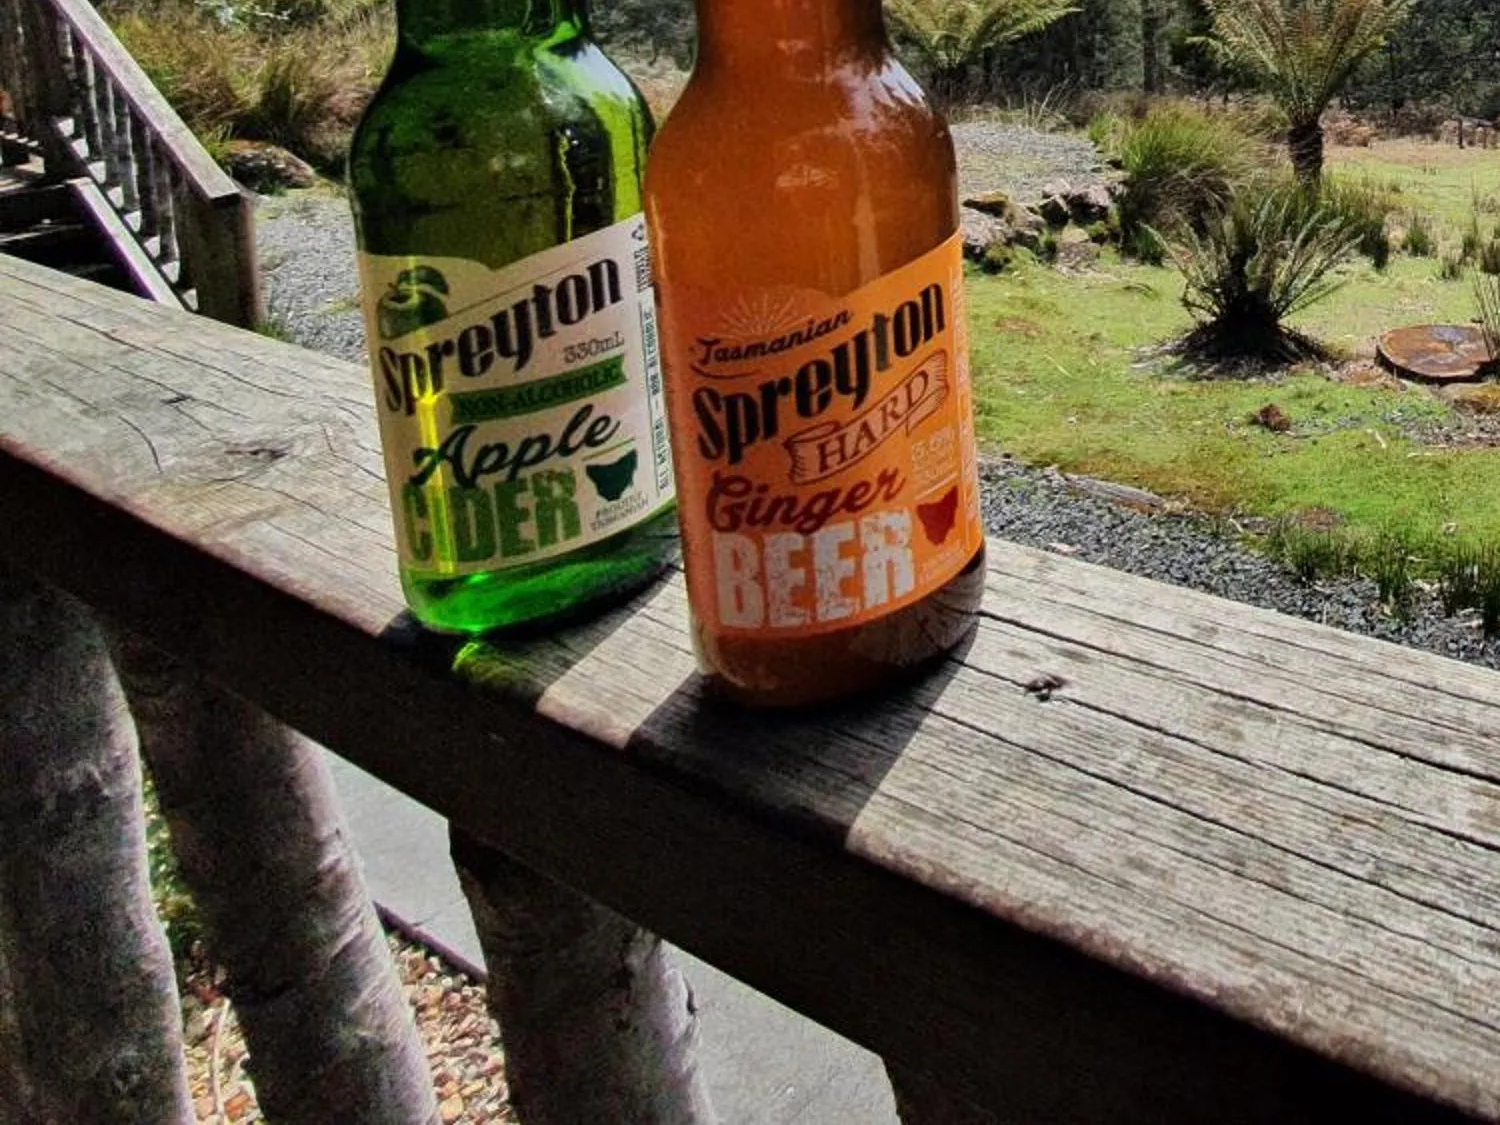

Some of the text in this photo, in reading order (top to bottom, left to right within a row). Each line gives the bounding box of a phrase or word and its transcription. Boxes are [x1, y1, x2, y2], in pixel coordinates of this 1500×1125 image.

[379, 258, 622, 416] Spreyton
[693, 283, 946, 465] Spreyton
[695, 309, 853, 365] Tasmanian
[409, 404, 620, 489] Apple
[818, 370, 929, 473] HARD
[706, 468, 905, 536] Ginger
[712, 508, 914, 629] BEER
